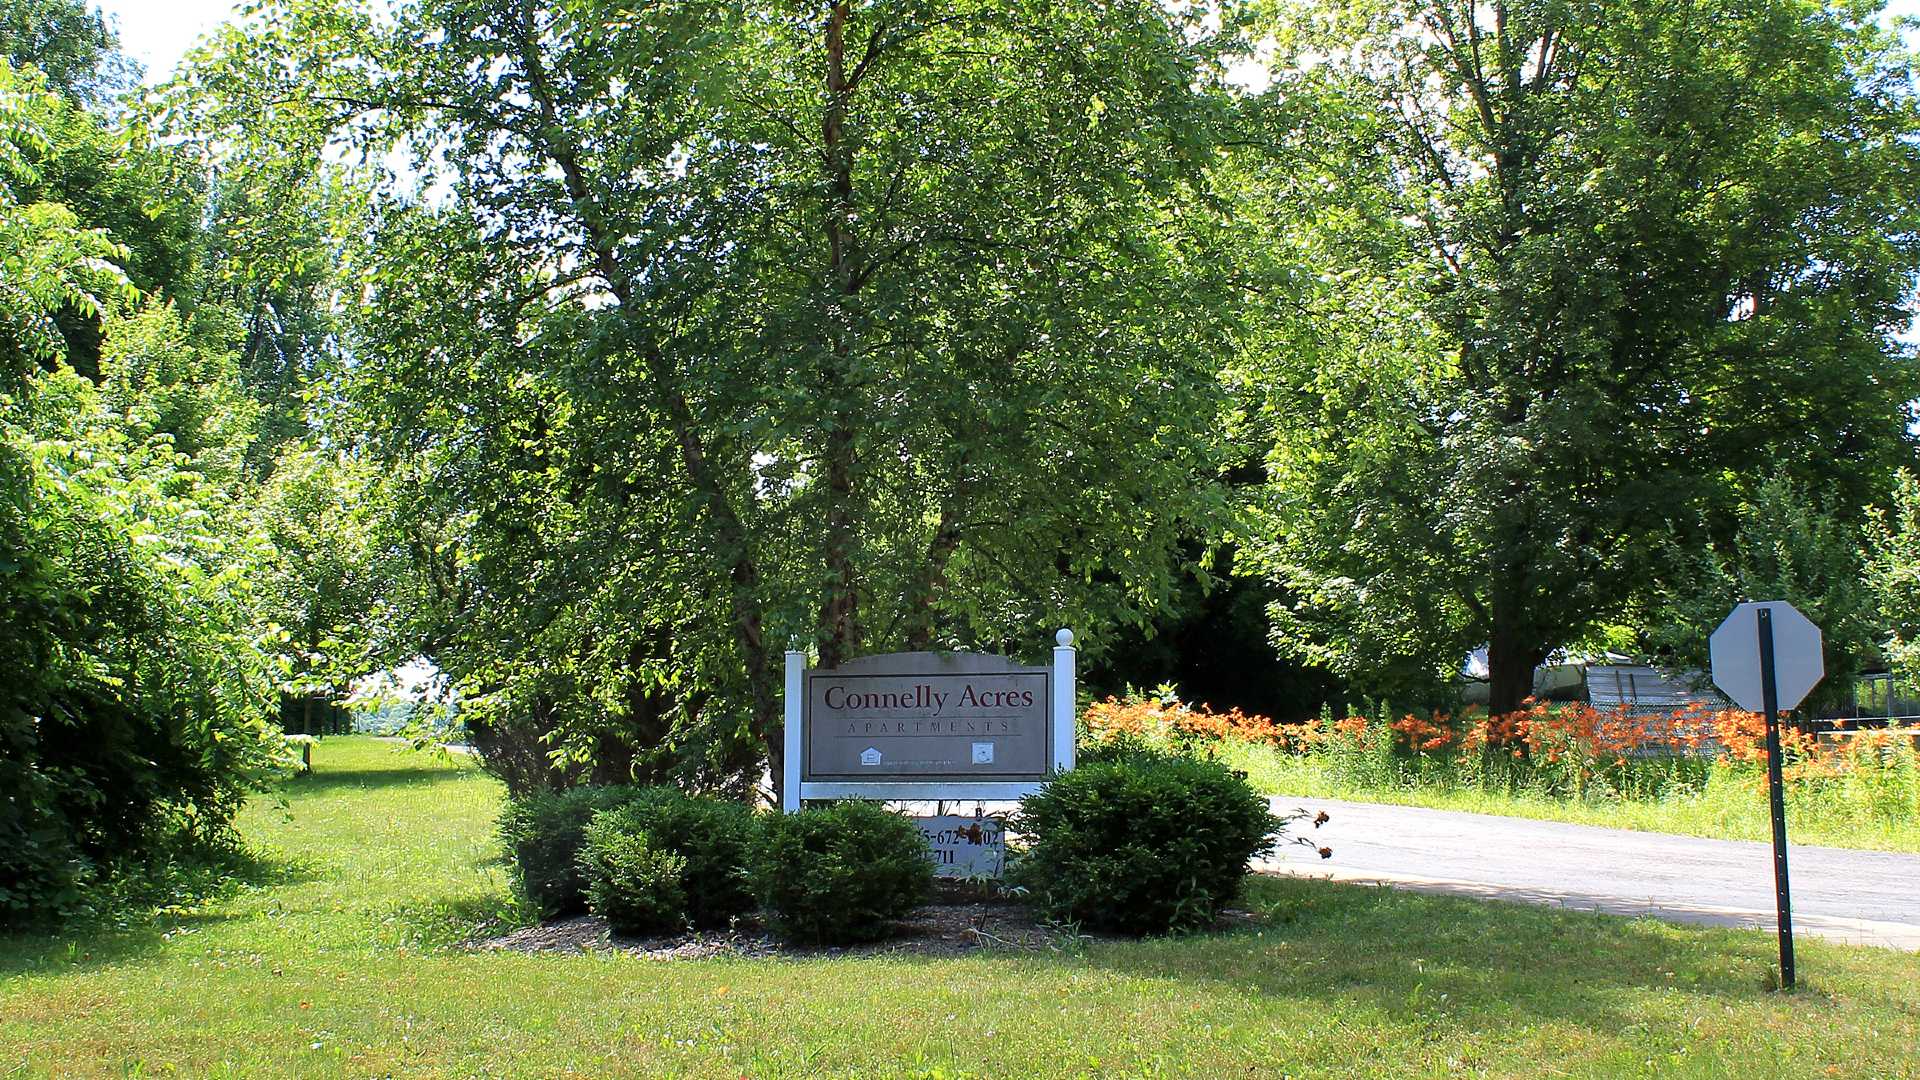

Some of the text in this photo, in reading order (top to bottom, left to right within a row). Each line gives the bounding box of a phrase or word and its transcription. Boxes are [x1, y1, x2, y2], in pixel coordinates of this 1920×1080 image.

[824, 684, 1034, 716] Connelly Acres
[847, 720, 1009, 734] APARTMENTS
